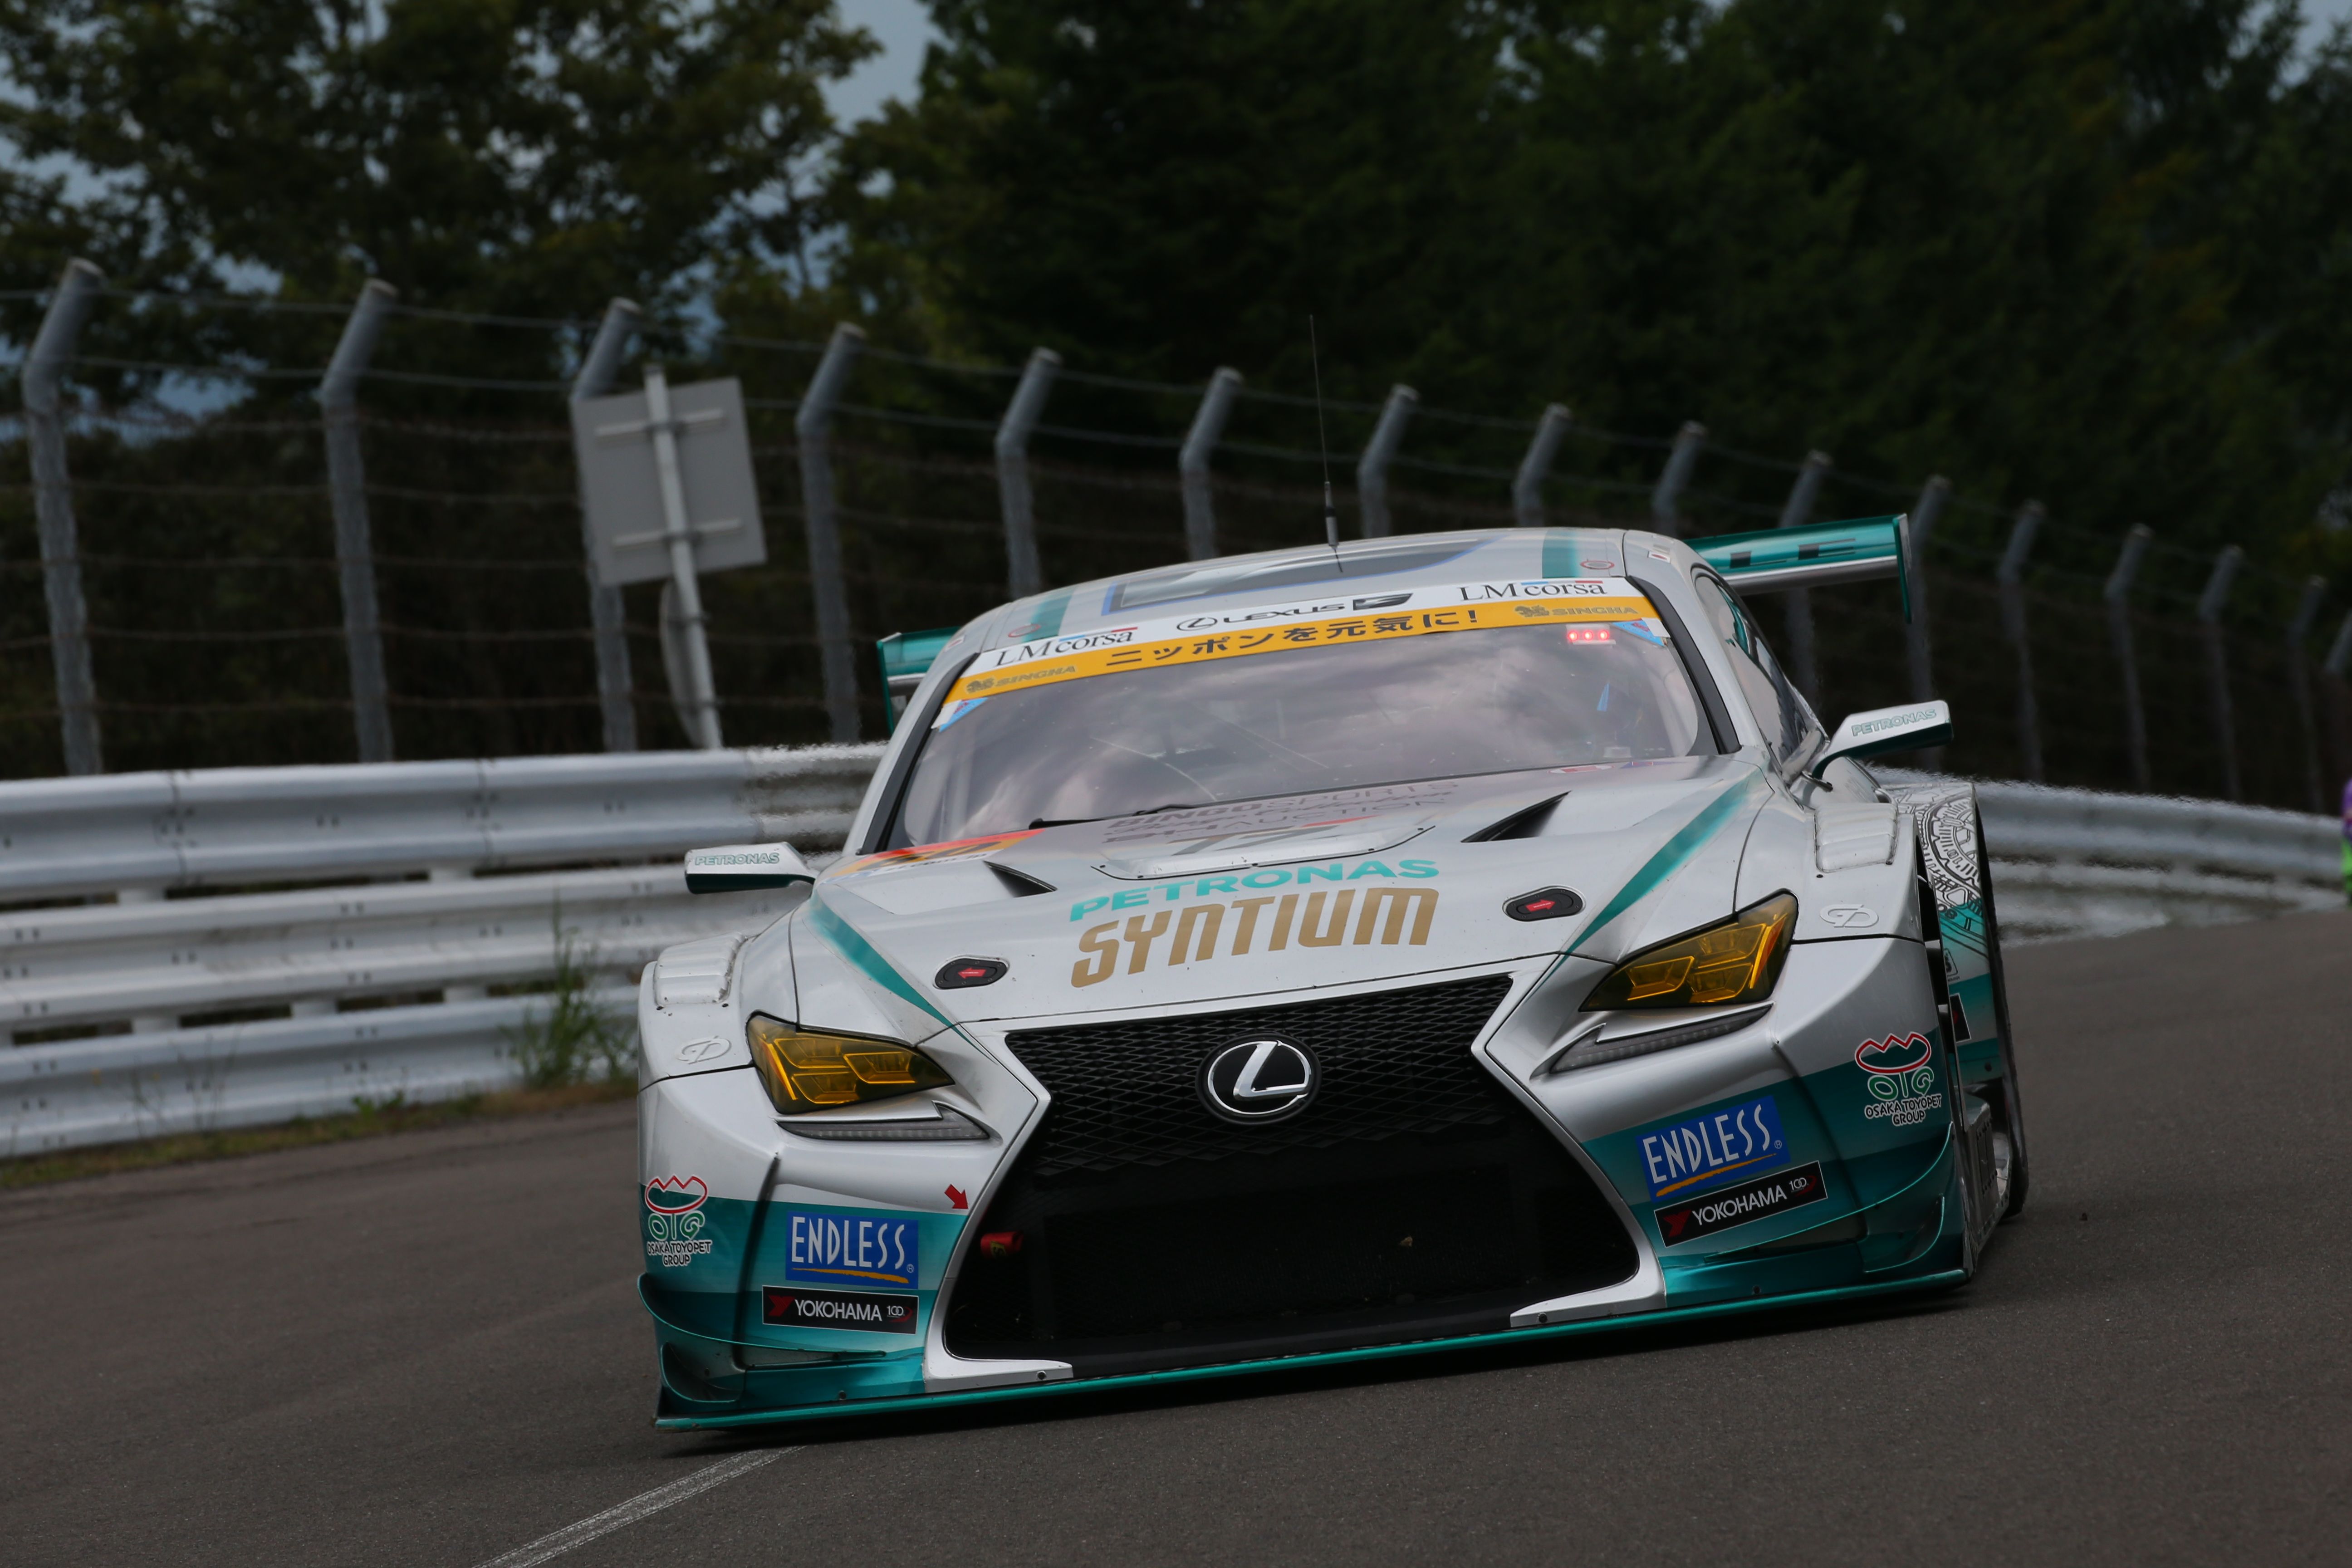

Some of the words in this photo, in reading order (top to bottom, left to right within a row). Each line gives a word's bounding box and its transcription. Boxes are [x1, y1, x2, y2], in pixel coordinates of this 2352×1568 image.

[1459, 583, 1520, 601] LM
[1524, 583, 1607, 596] corsa
[1224, 603, 1345, 623] LEXUS
[1552, 606, 1638, 616] SINGHA
[994, 641, 1054, 667] LM
[1055, 630, 1133, 653] corsa
[995, 665, 1076, 687] SINGHA
[1852, 709, 1937, 737] PETRONAS
[695, 853, 779, 866] PETRONAS
[1070, 859, 1440, 922] PETRONAS
[1071, 887, 1439, 988] SYNTIUM
[1865, 1101, 1901, 1119] OSAKA
[1902, 1093, 1942, 1113] TOYOPET
[1892, 1110, 1926, 1127] GROUP
[1643, 1104, 1771, 1184] ENDLESS
[1691, 1184, 1787, 1226] YOKOHAMA
[647, 1240, 671, 1255] OSAKA
[672, 1239, 712, 1254] TOYOPET
[791, 1216, 906, 1269] ENDLESS
[662, 1253, 691, 1267] GROUP
[794, 1298, 882, 1322] YOKOHAMA
